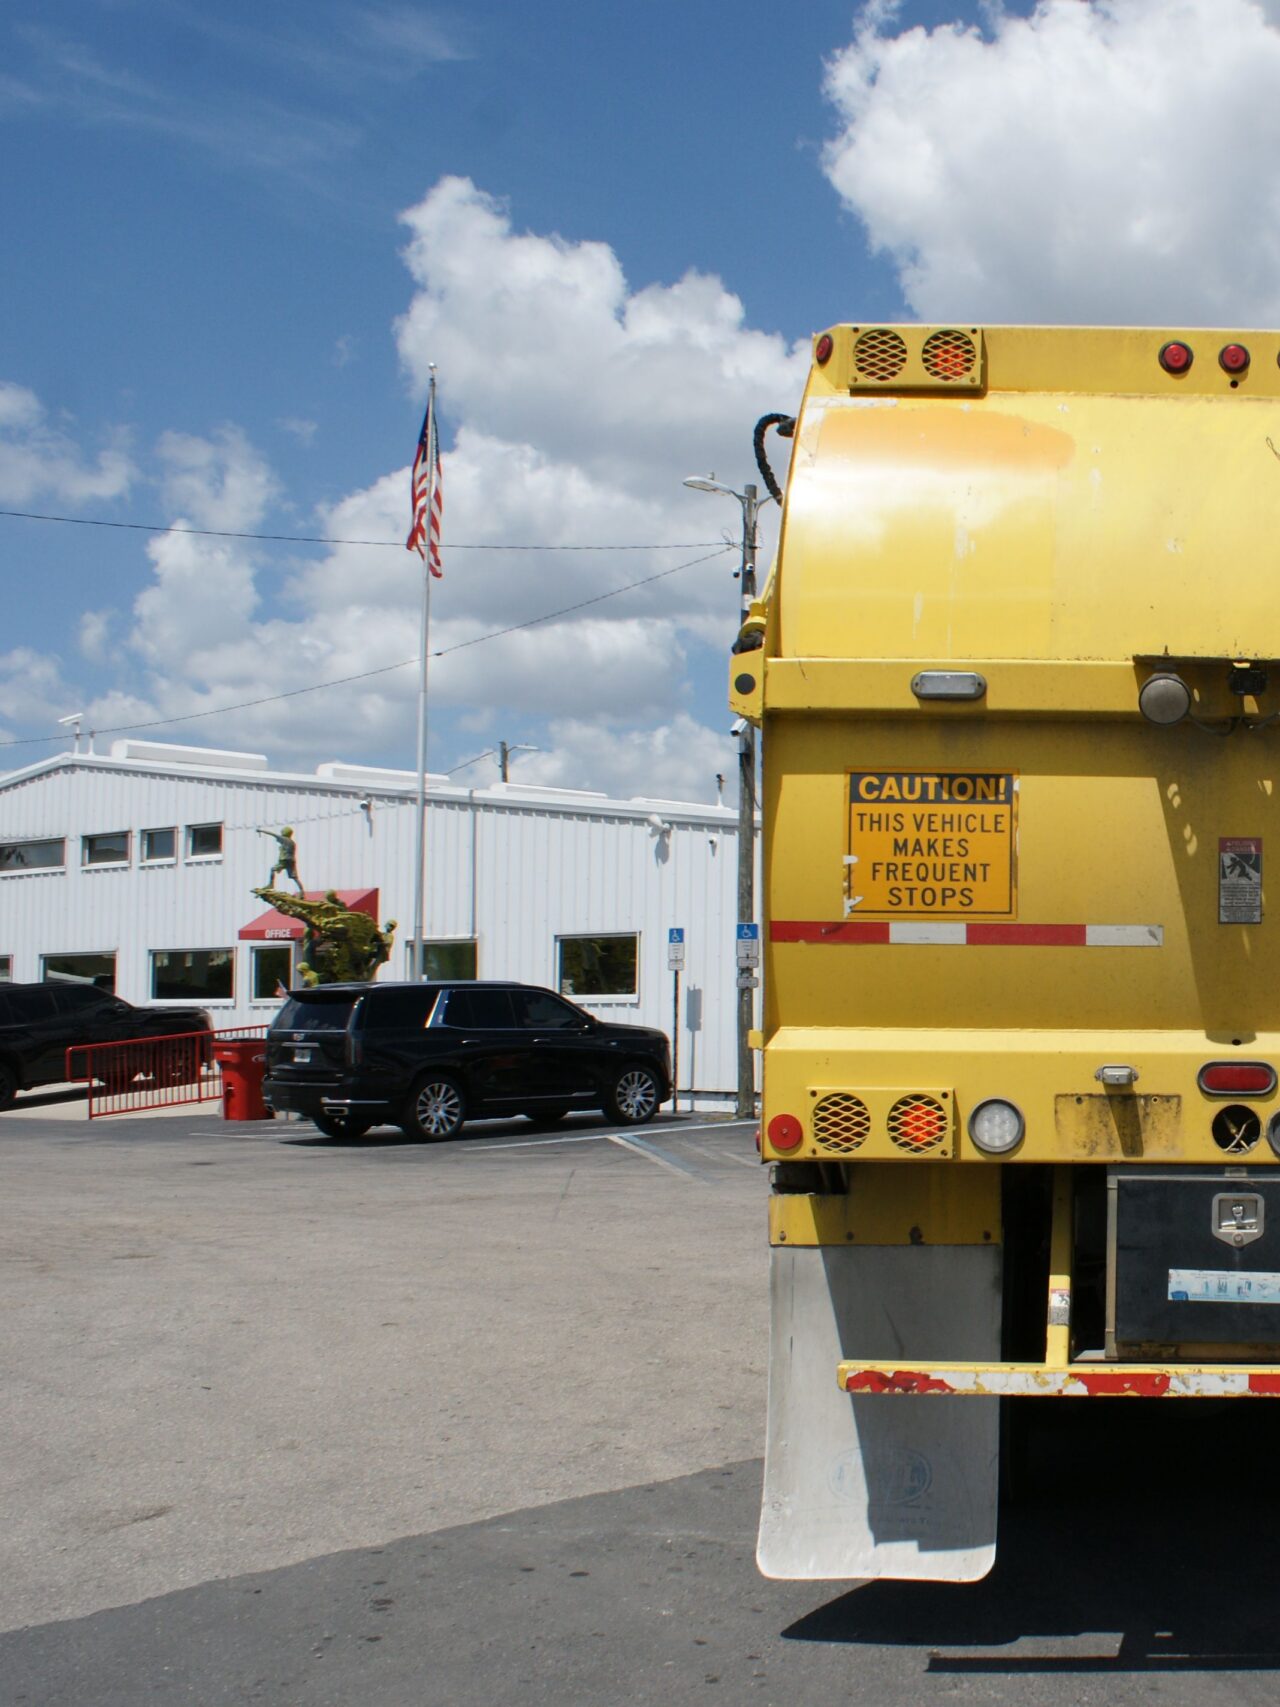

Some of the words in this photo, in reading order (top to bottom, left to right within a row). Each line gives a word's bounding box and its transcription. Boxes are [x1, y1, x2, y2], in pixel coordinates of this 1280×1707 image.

[858, 776, 1006, 801] CAUTION!
[856, 813, 905, 832] THIS
[912, 813, 1006, 833] VEHICLE
[893, 838, 969, 858] MAKES
[872, 862, 991, 882] FREQUENT
[888, 887, 974, 907] STOPS
[265, 928, 291, 938] OFFICE
